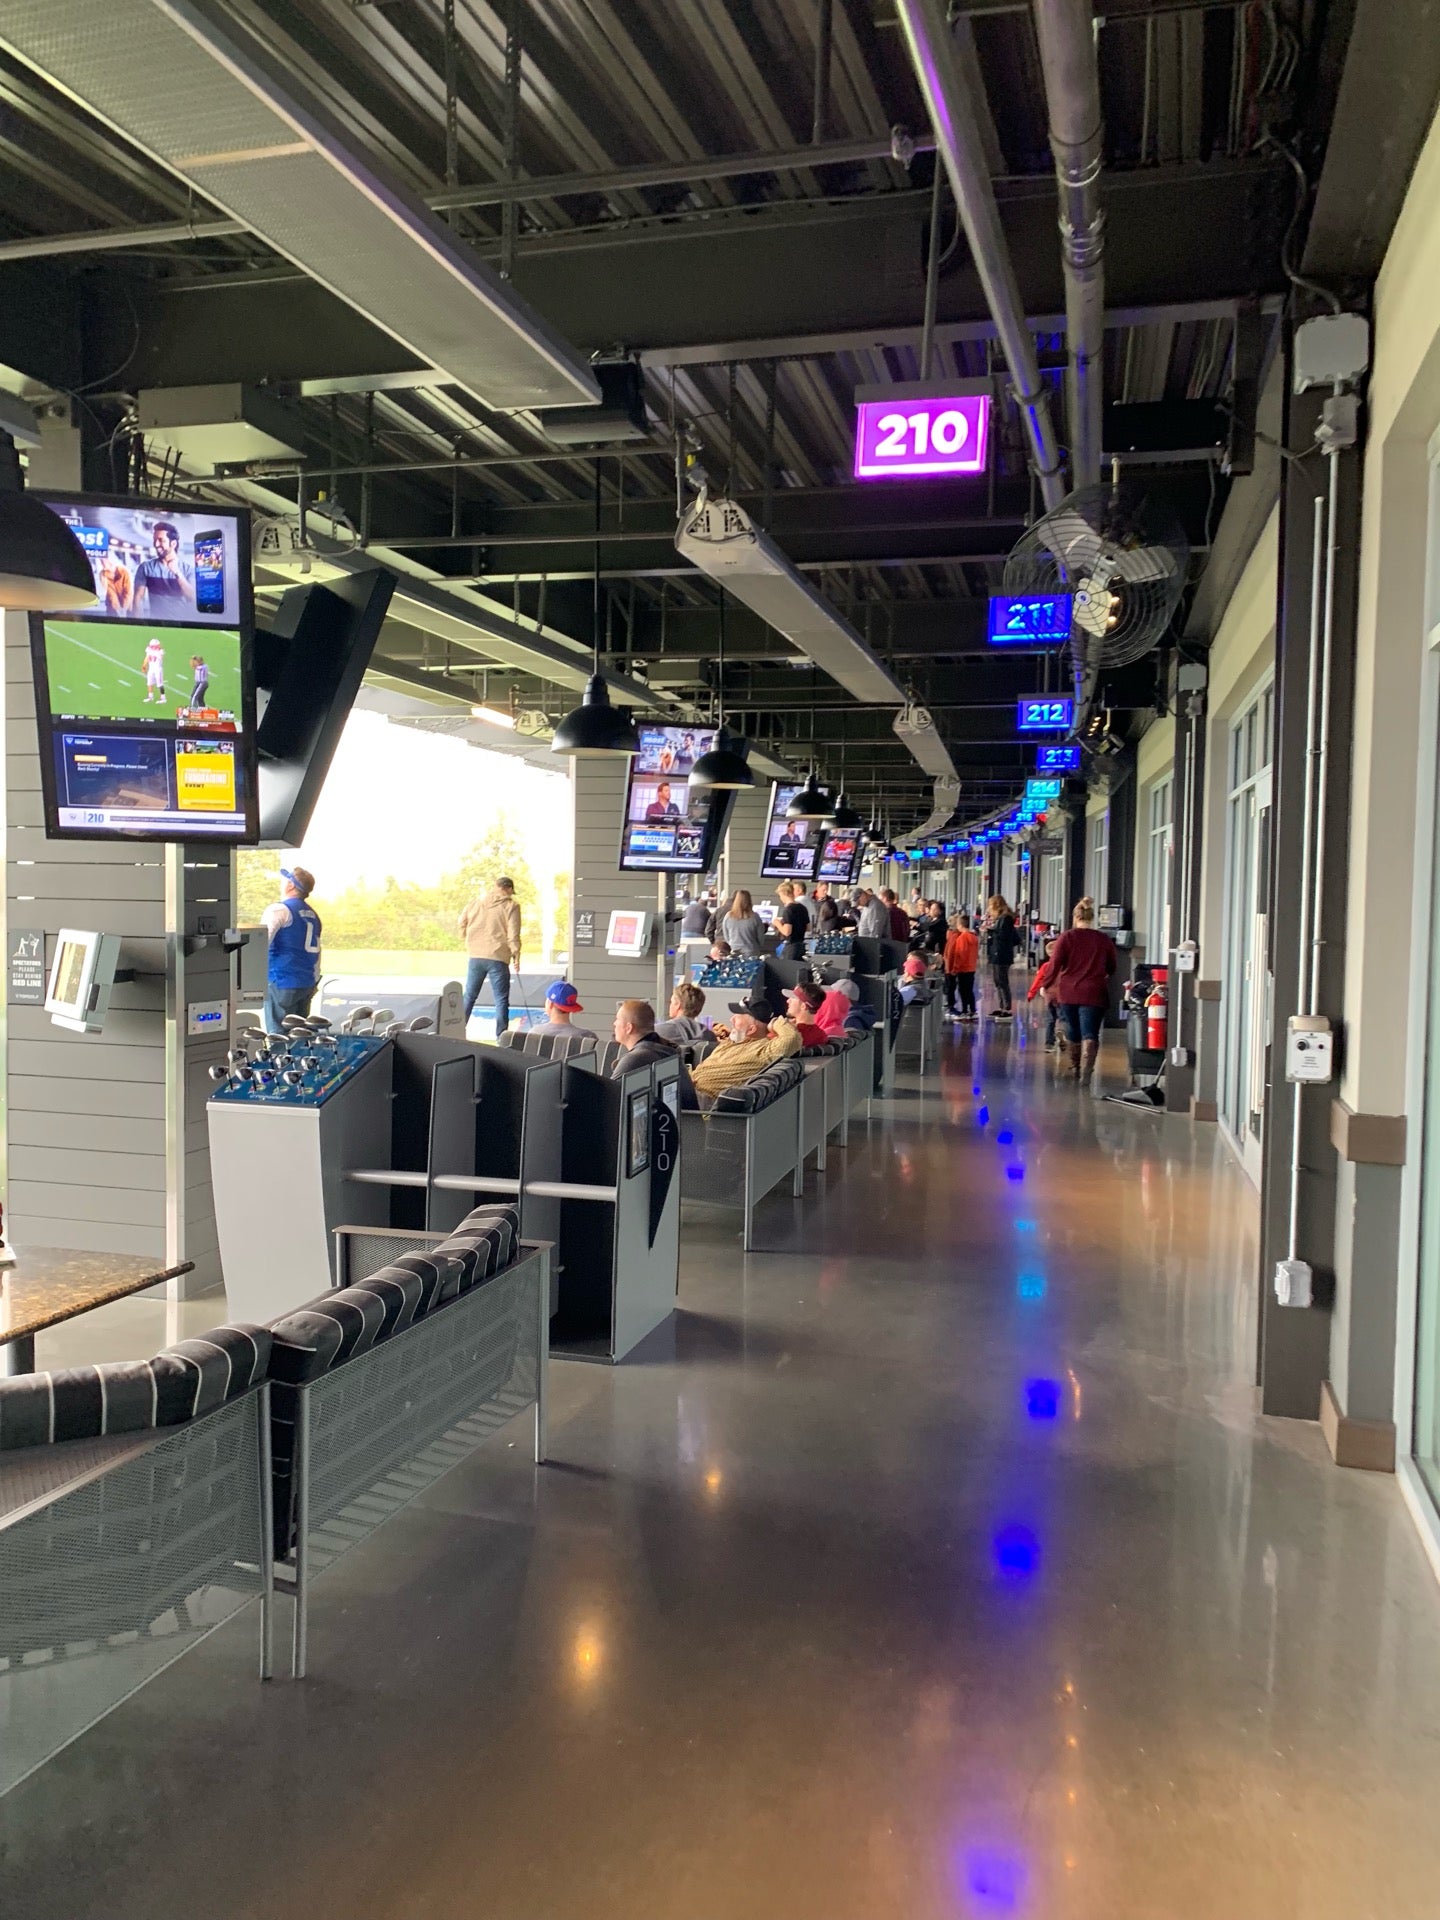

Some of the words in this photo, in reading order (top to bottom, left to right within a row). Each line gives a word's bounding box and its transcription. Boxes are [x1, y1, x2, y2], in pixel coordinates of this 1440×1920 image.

[875, 410, 969, 457] 210
[75, 531, 104, 546] ost
[1007, 602, 1054, 630] 211
[1027, 704, 1064, 722] 212
[1046, 749, 1073, 763] 213
[1031, 781, 1056, 793] 214
[1026, 799, 1046, 809] 215
[87, 813, 105, 823] 210
[12, 979, 26, 987] RED
[26, 979, 42, 988] LINE
[658, 1113, 671, 1172] 210
